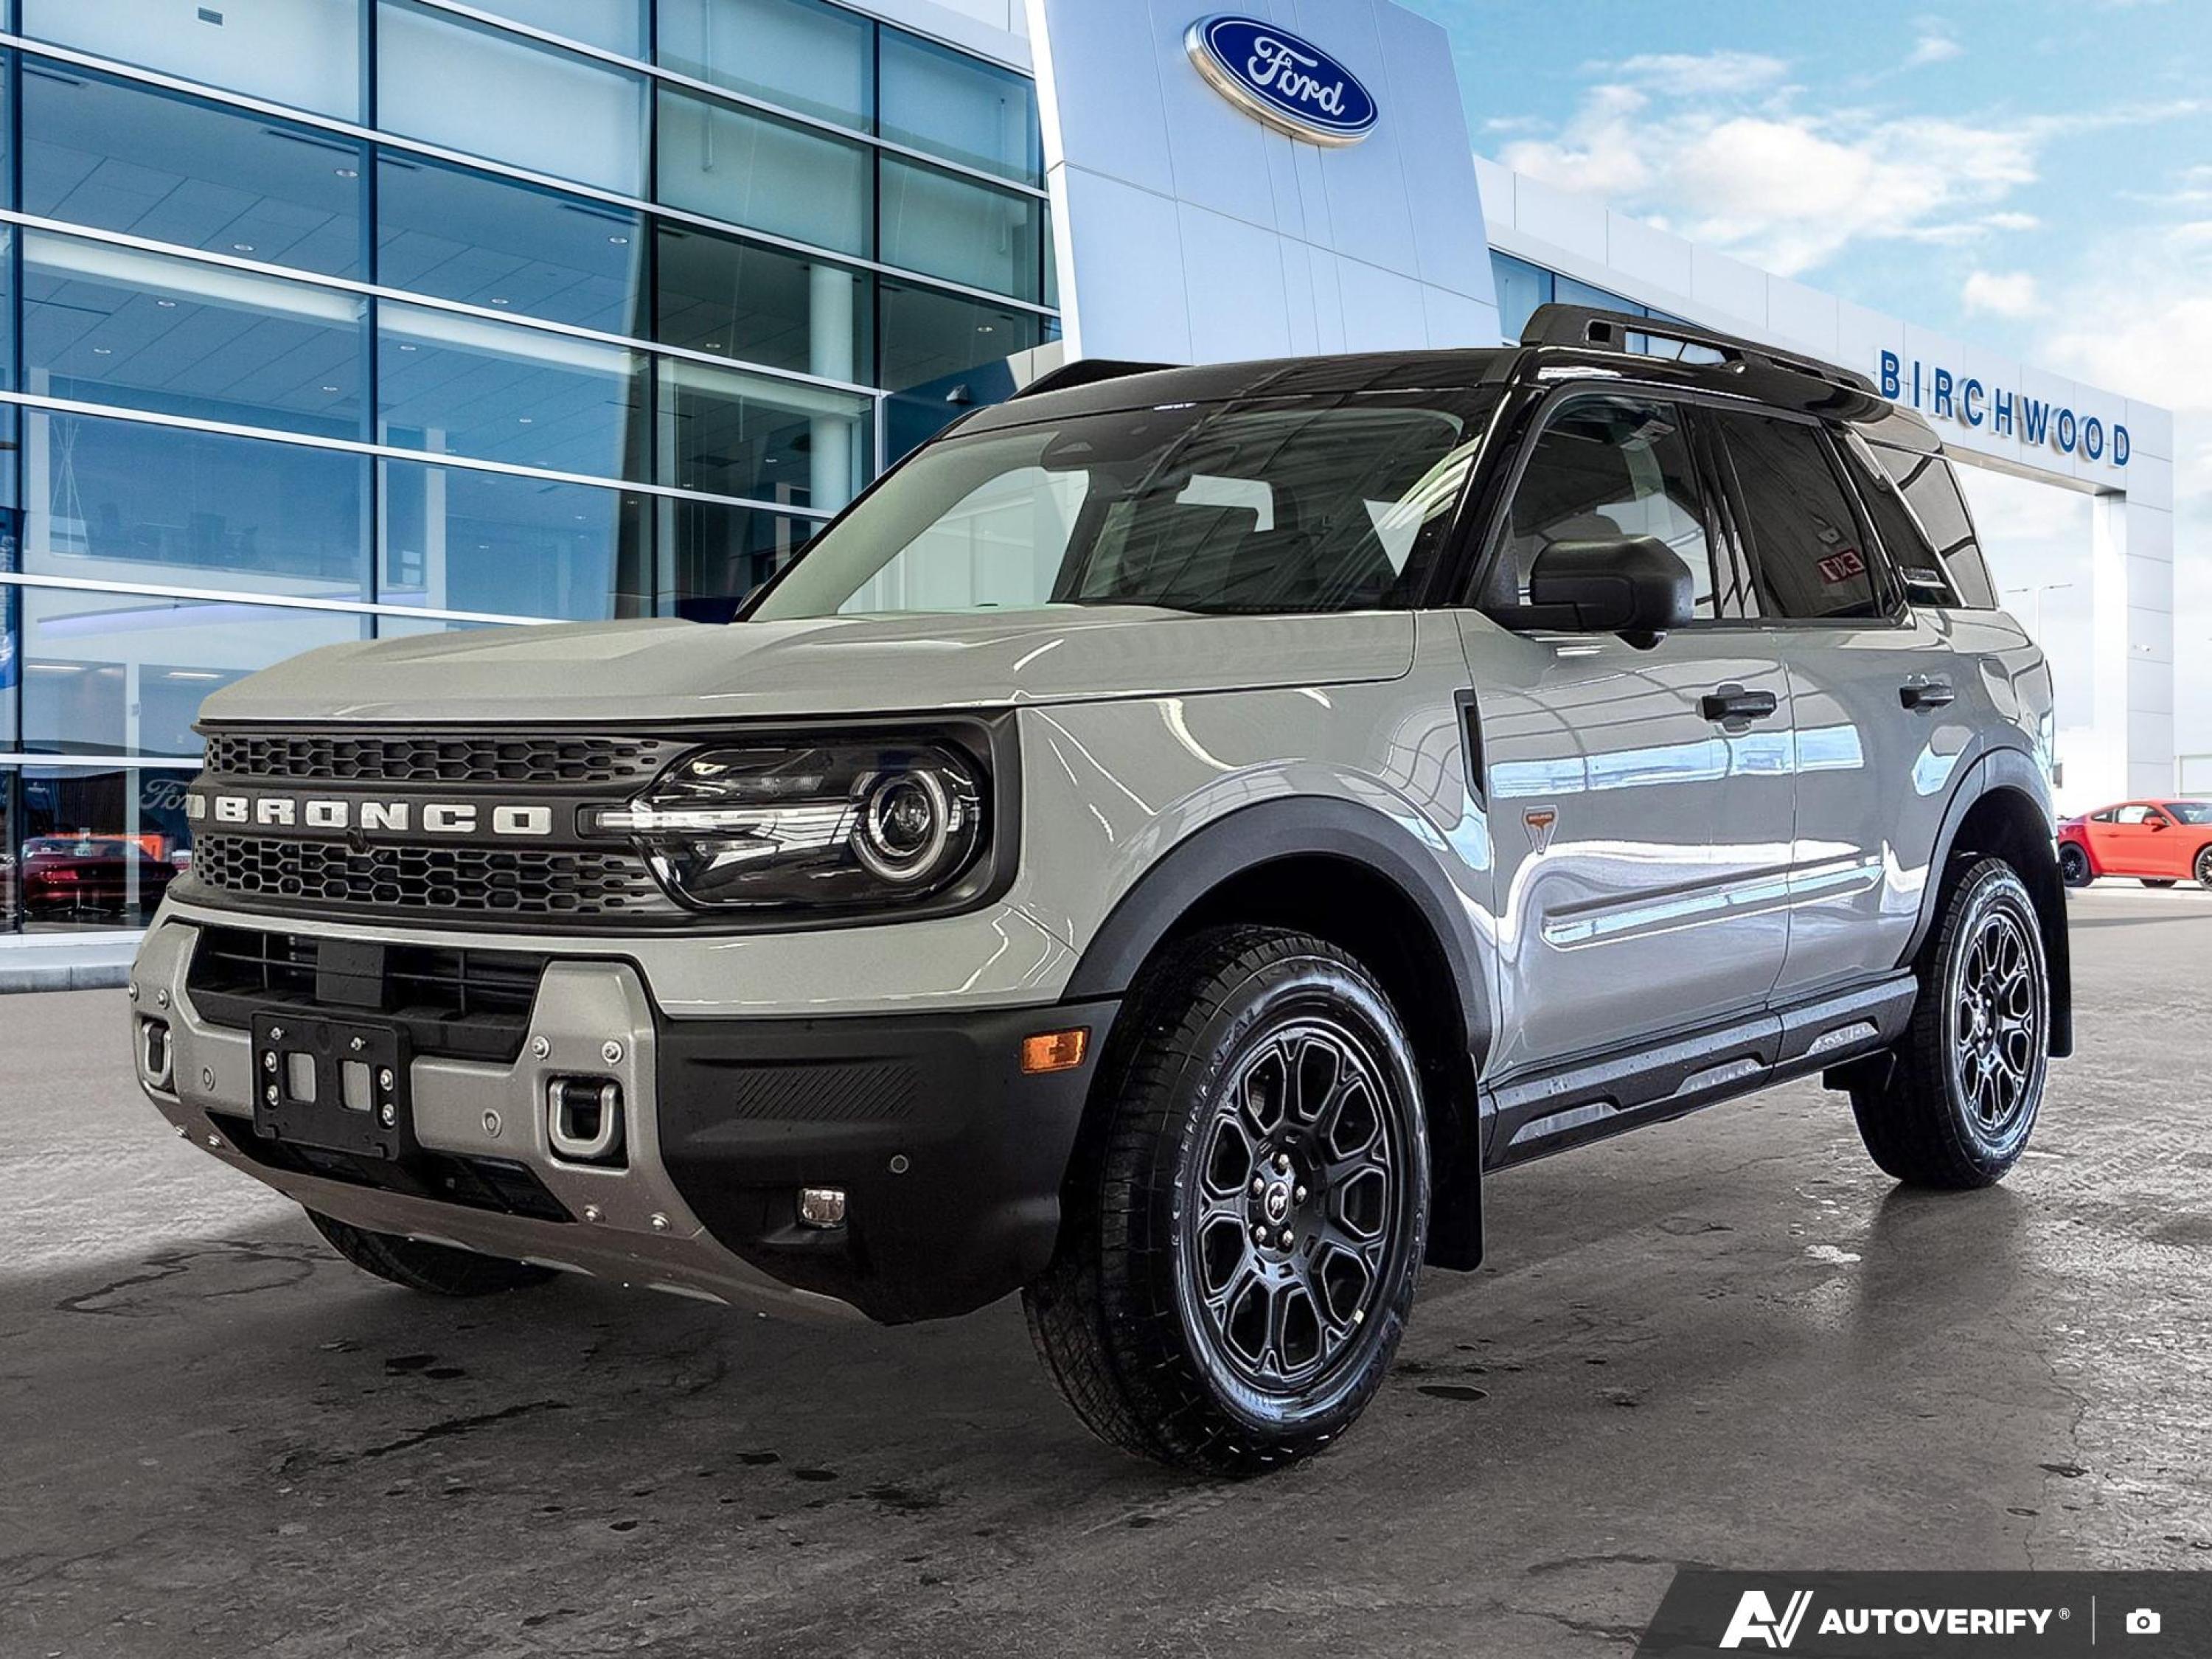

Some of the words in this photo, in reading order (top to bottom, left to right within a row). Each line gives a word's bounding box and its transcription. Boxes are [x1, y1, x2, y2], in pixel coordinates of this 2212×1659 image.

[1248, 36, 1345, 116] Ford
[1881, 349, 2131, 466] BIRCHWOOD
[215, 796, 552, 835] BRONCO
